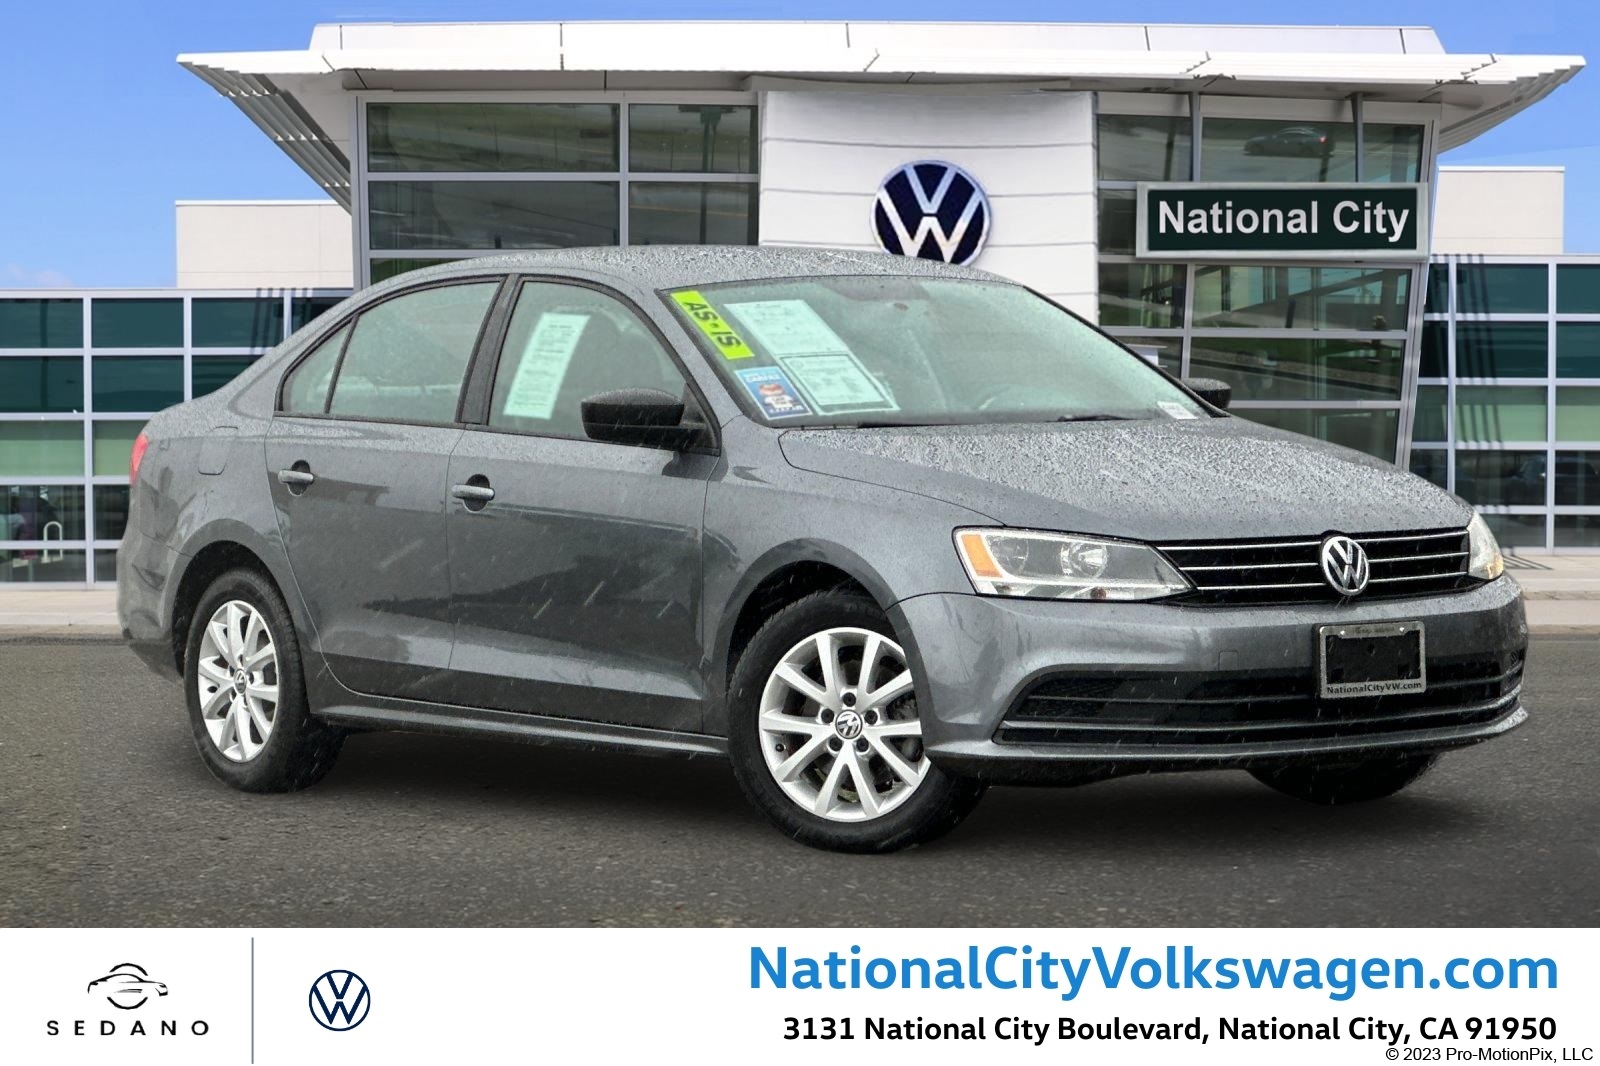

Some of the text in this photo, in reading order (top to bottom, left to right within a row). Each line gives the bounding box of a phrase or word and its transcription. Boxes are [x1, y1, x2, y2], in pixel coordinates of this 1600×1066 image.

[871, 160, 991, 266] VW
[1157, 200, 1411, 243] National City
[1322, 536, 1369, 595] VW
[1326, 682, 1422, 695] NationalCityVW.com
